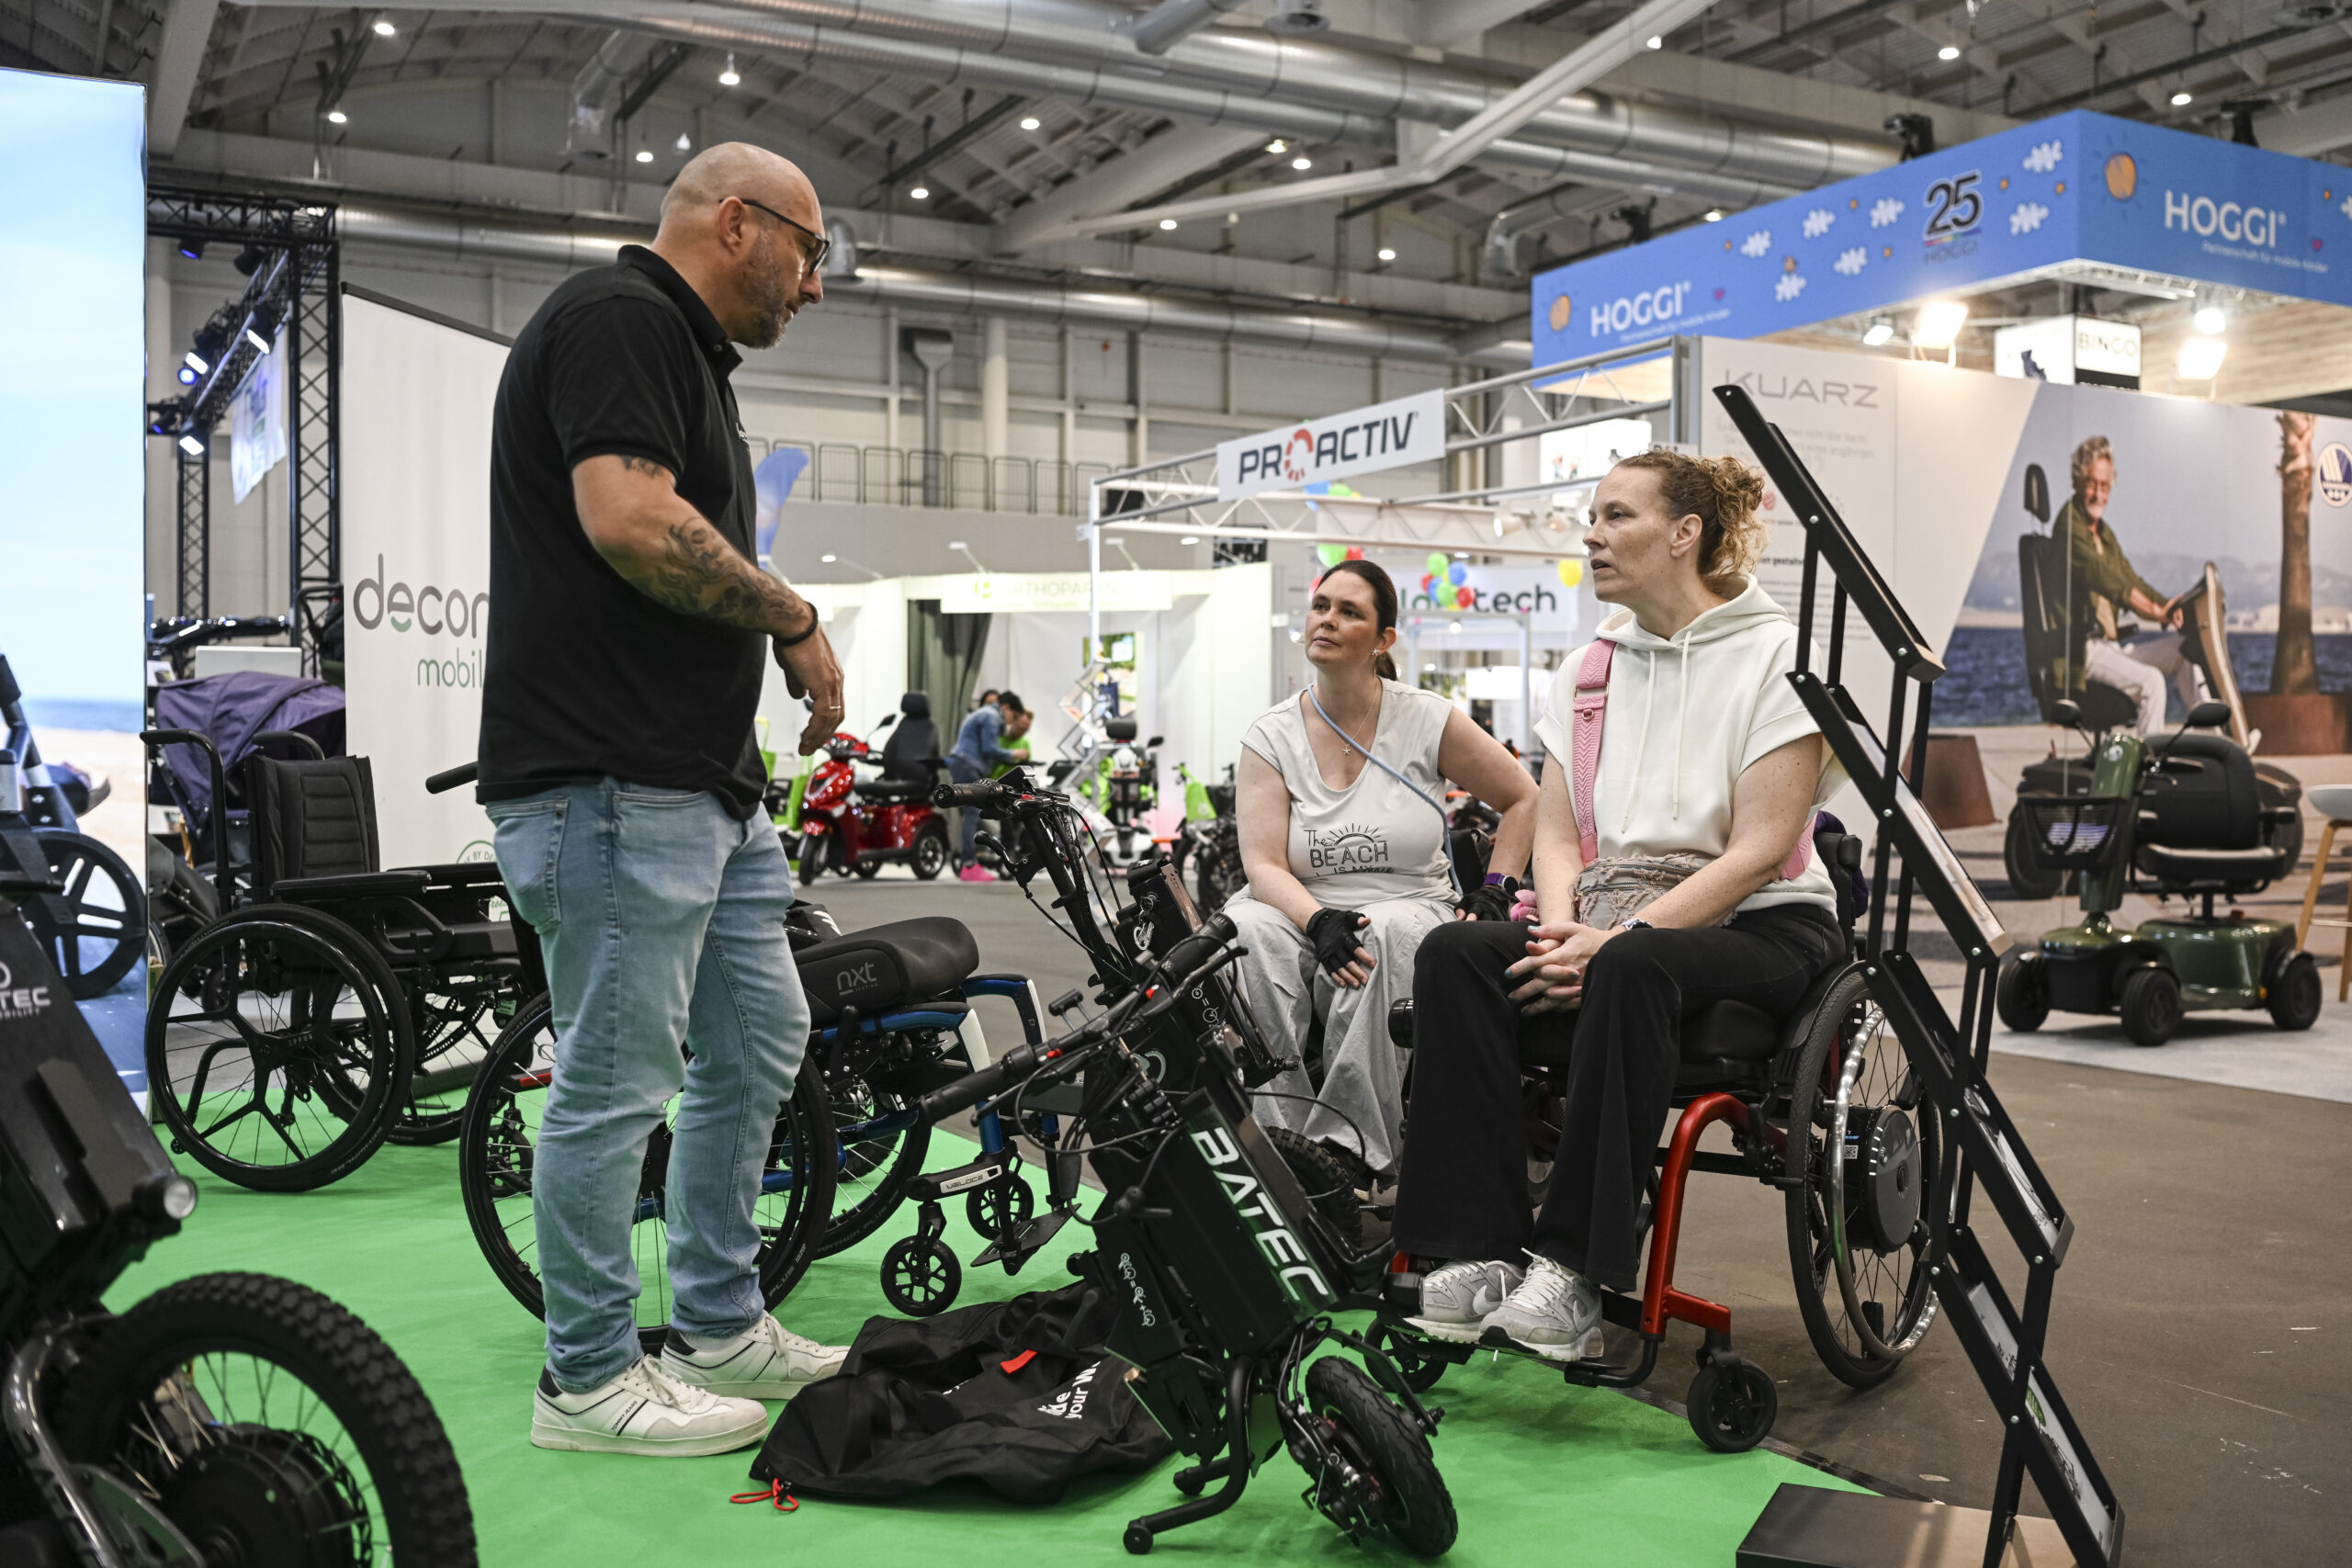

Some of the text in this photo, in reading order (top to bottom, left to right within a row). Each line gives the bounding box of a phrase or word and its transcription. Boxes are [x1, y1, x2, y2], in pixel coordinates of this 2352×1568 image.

[1922, 171, 1983, 239] 25
[2165, 189, 2277, 248] HOGGI
[1590, 282, 1683, 338] HOGGI
[1725, 369, 1878, 409] KUARZ
[1238, 412, 1416, 484] PROACTIV
[1304, 829, 1332, 847] The
[1310, 840, 1388, 868] BEACH
[1190, 1127, 1329, 1301] BATEC
